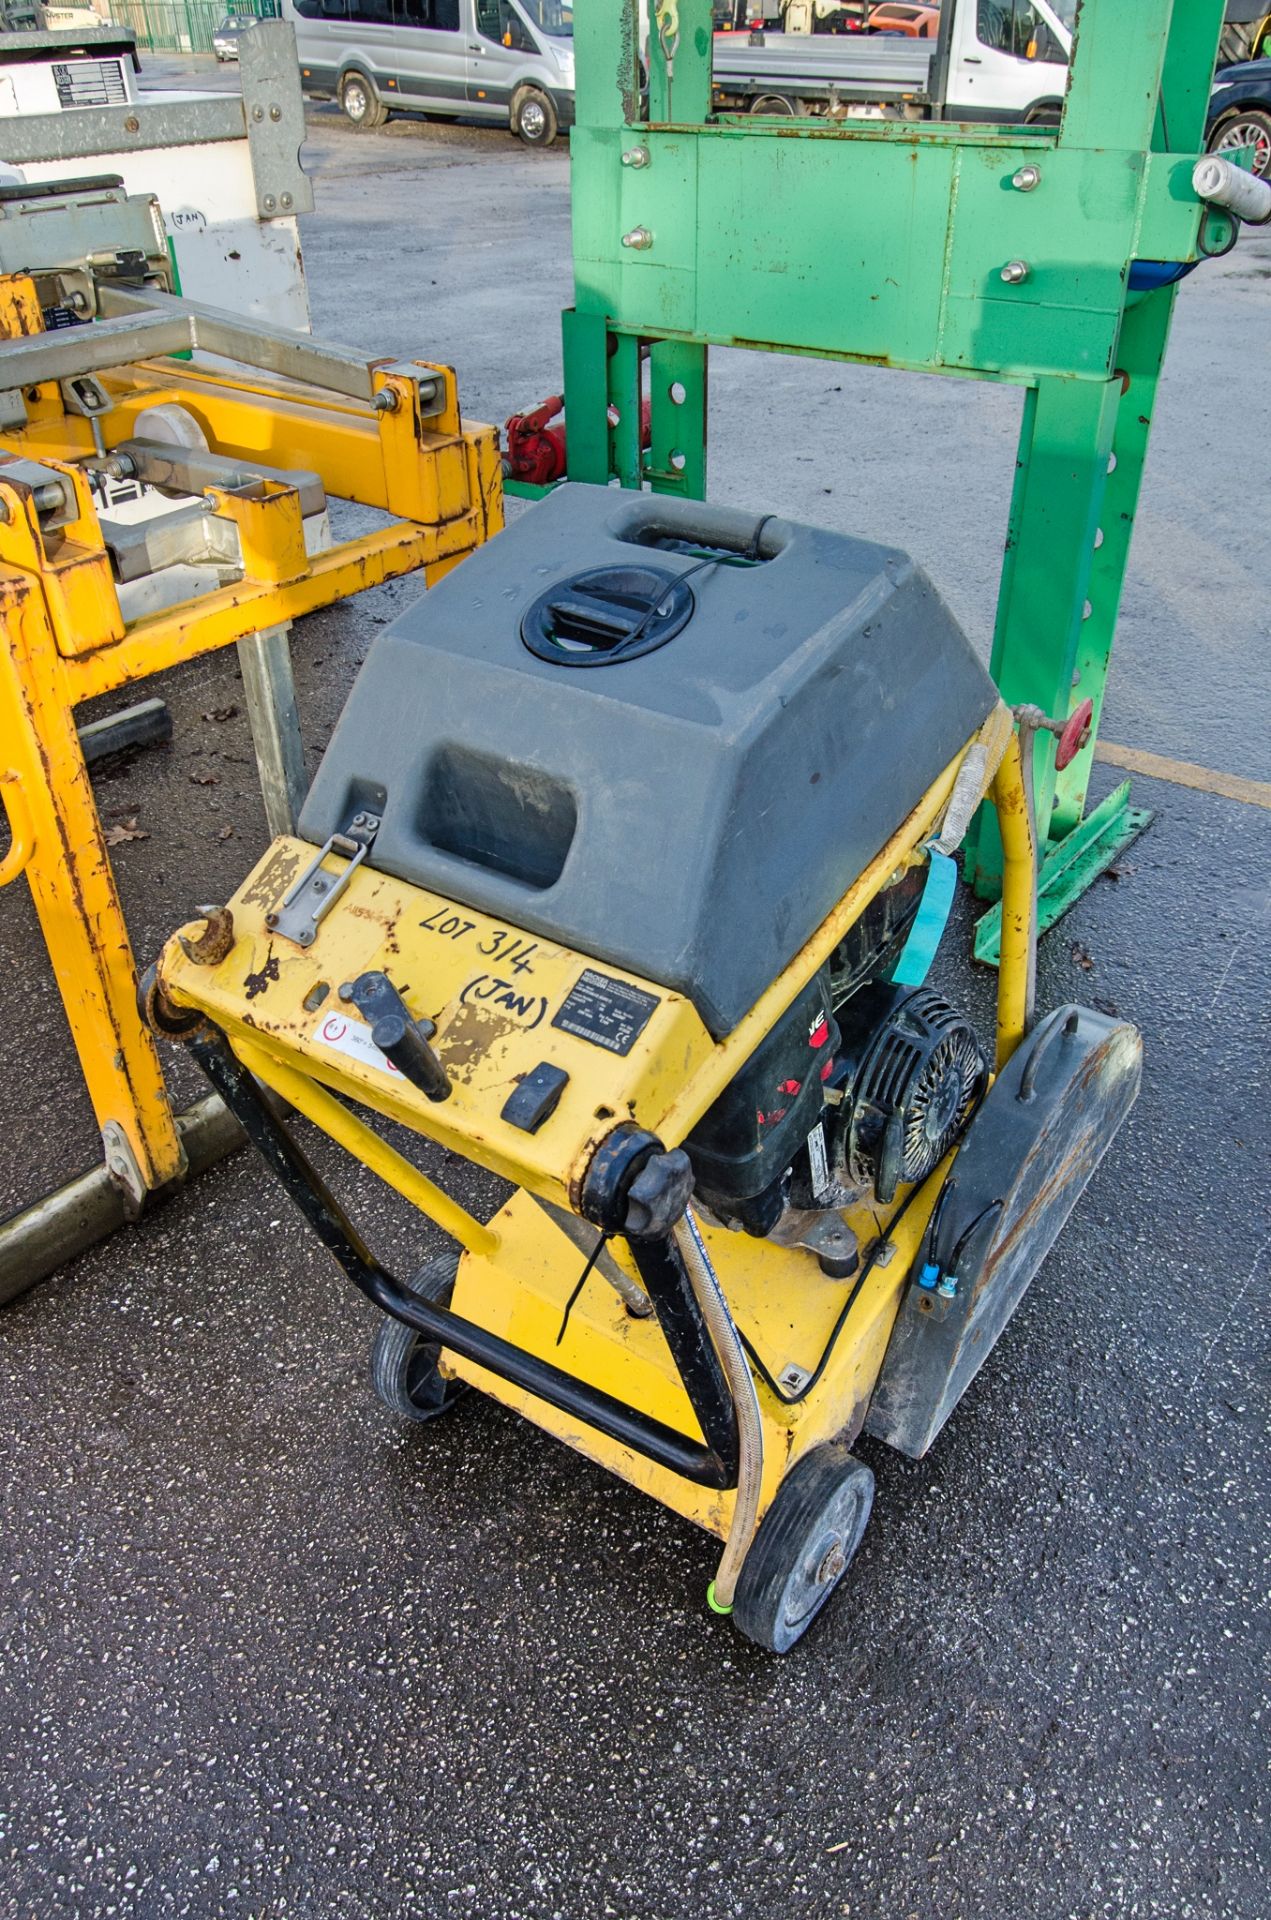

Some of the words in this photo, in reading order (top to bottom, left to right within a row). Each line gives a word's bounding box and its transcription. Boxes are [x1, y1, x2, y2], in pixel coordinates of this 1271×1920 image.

[171, 210, 207, 231] (JAN)
[419, 908, 476, 939] LOT
[478, 931, 538, 975] 314
[460, 975, 549, 1029] (JAN)
